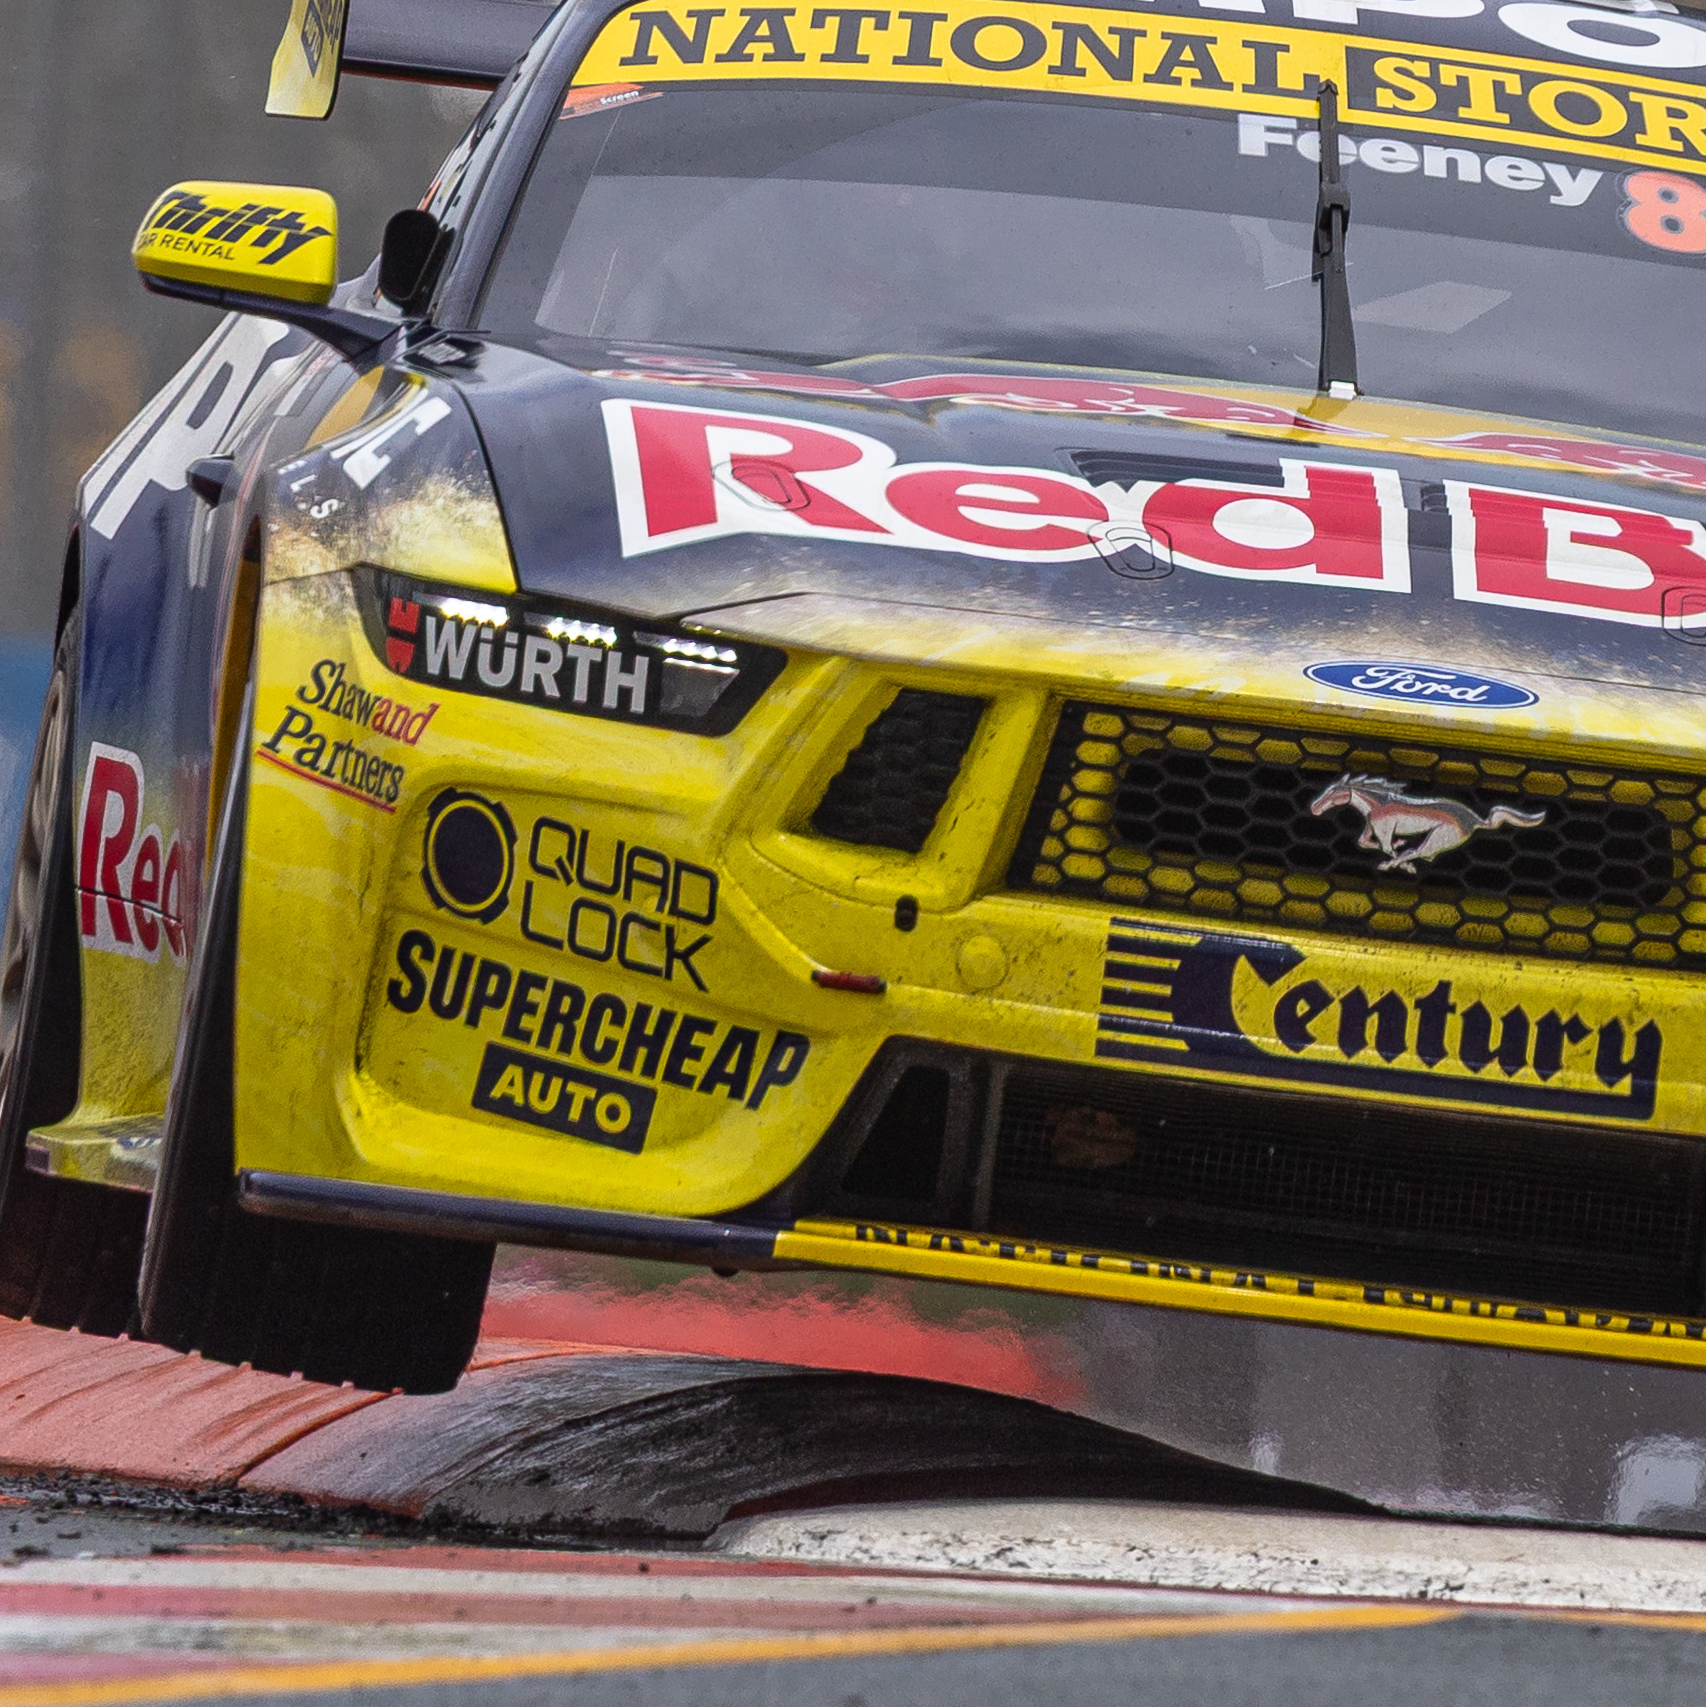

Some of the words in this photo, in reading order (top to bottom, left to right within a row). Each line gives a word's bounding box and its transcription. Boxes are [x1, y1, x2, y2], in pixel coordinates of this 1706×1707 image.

[619, 7, 1319, 100] NATIONAL
[1236, 113, 1604, 208] Feeney
[141, 190, 332, 266] Thrifty
[160, 234, 237, 261] RENTAL
[601, 397, 1412, 593] Red
[424, 614, 650, 715] WÜRTH
[1350, 665, 1491, 703] Ford
[261, 704, 407, 805] Partners
[527, 817, 720, 927] QUAD
[519, 878, 713, 995] LOCK
[386, 928, 811, 1112] SUPERCHEAP
[1143, 928, 1664, 1121] Century
[489, 1063, 634, 1135] AUTO
